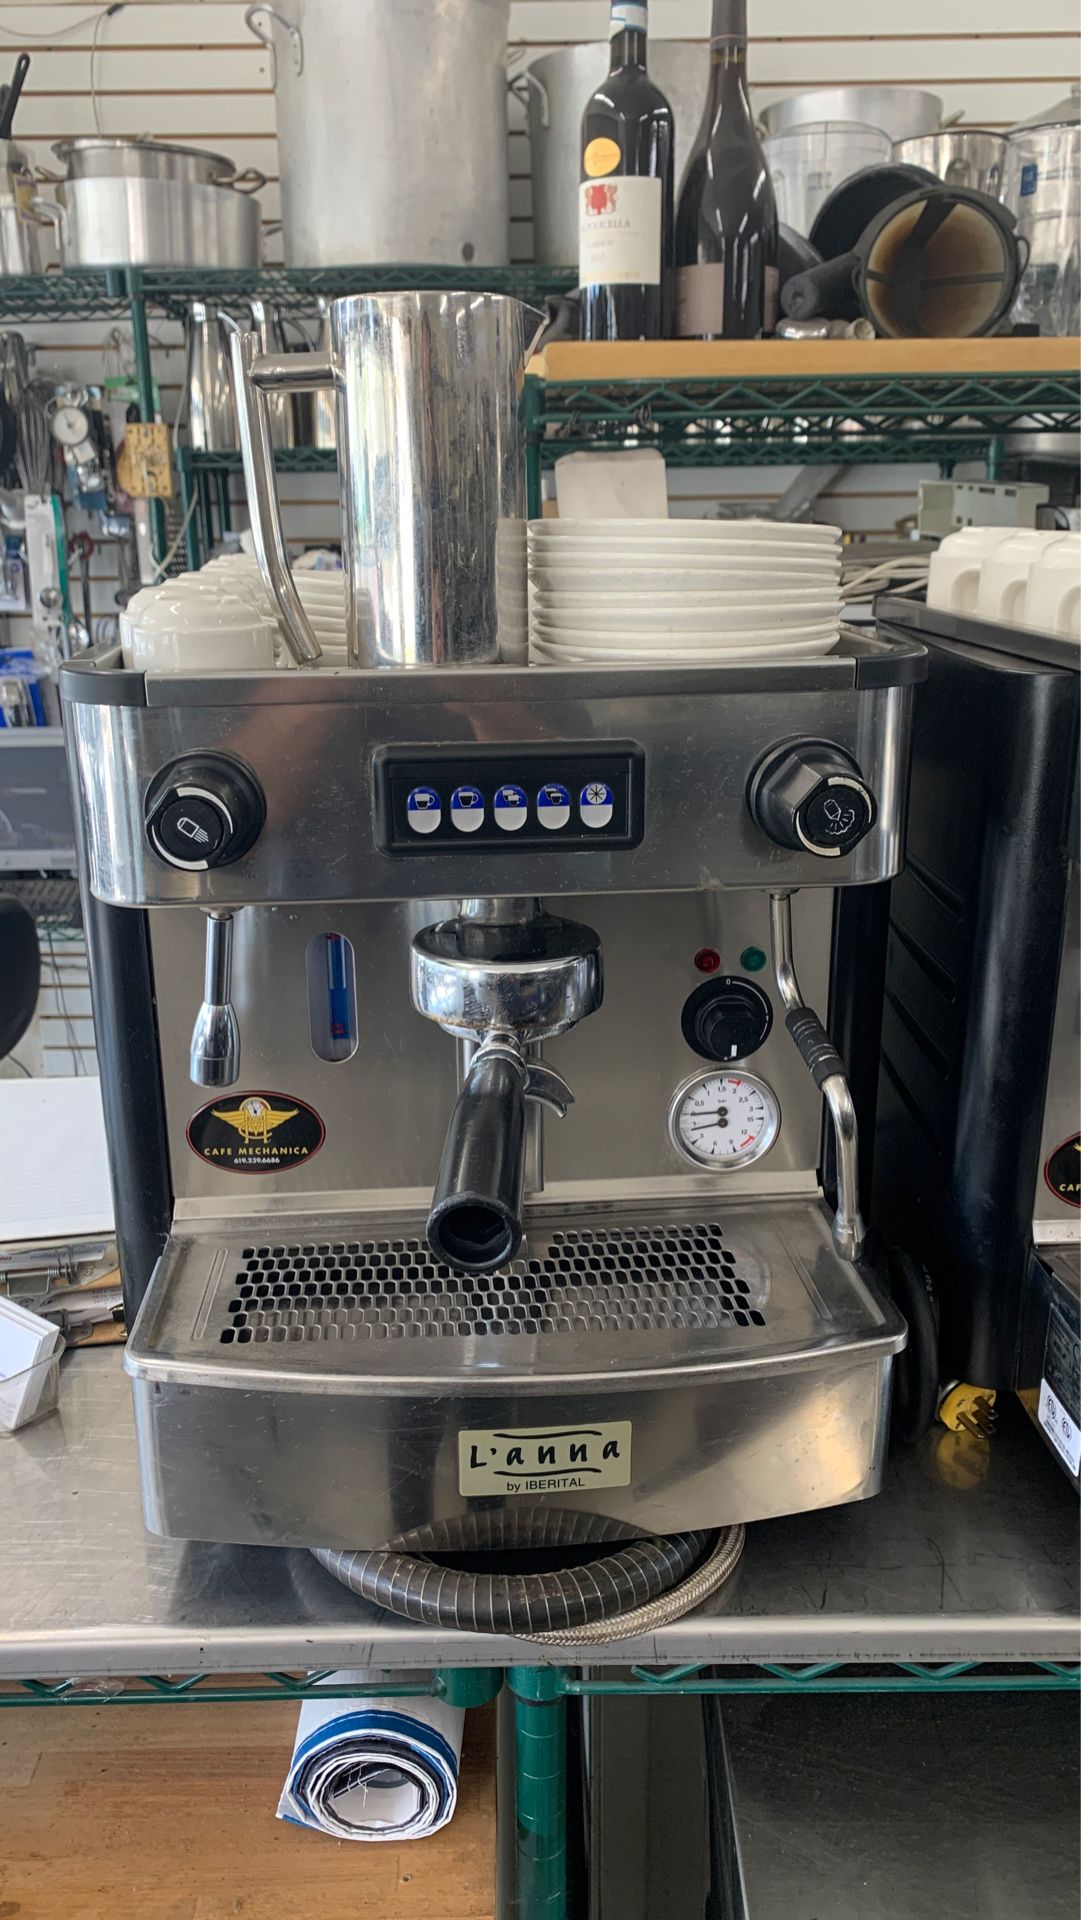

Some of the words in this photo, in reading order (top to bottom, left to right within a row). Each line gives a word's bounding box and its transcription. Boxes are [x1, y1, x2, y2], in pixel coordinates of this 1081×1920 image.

[204, 1147, 232, 1156] CAFE
[238, 1146, 309, 1155] MECHANICA
[470, 1440, 620, 1469] L'anna
[506, 1481, 521, 1493] by
[525, 1477, 586, 1491] IBERITAL
